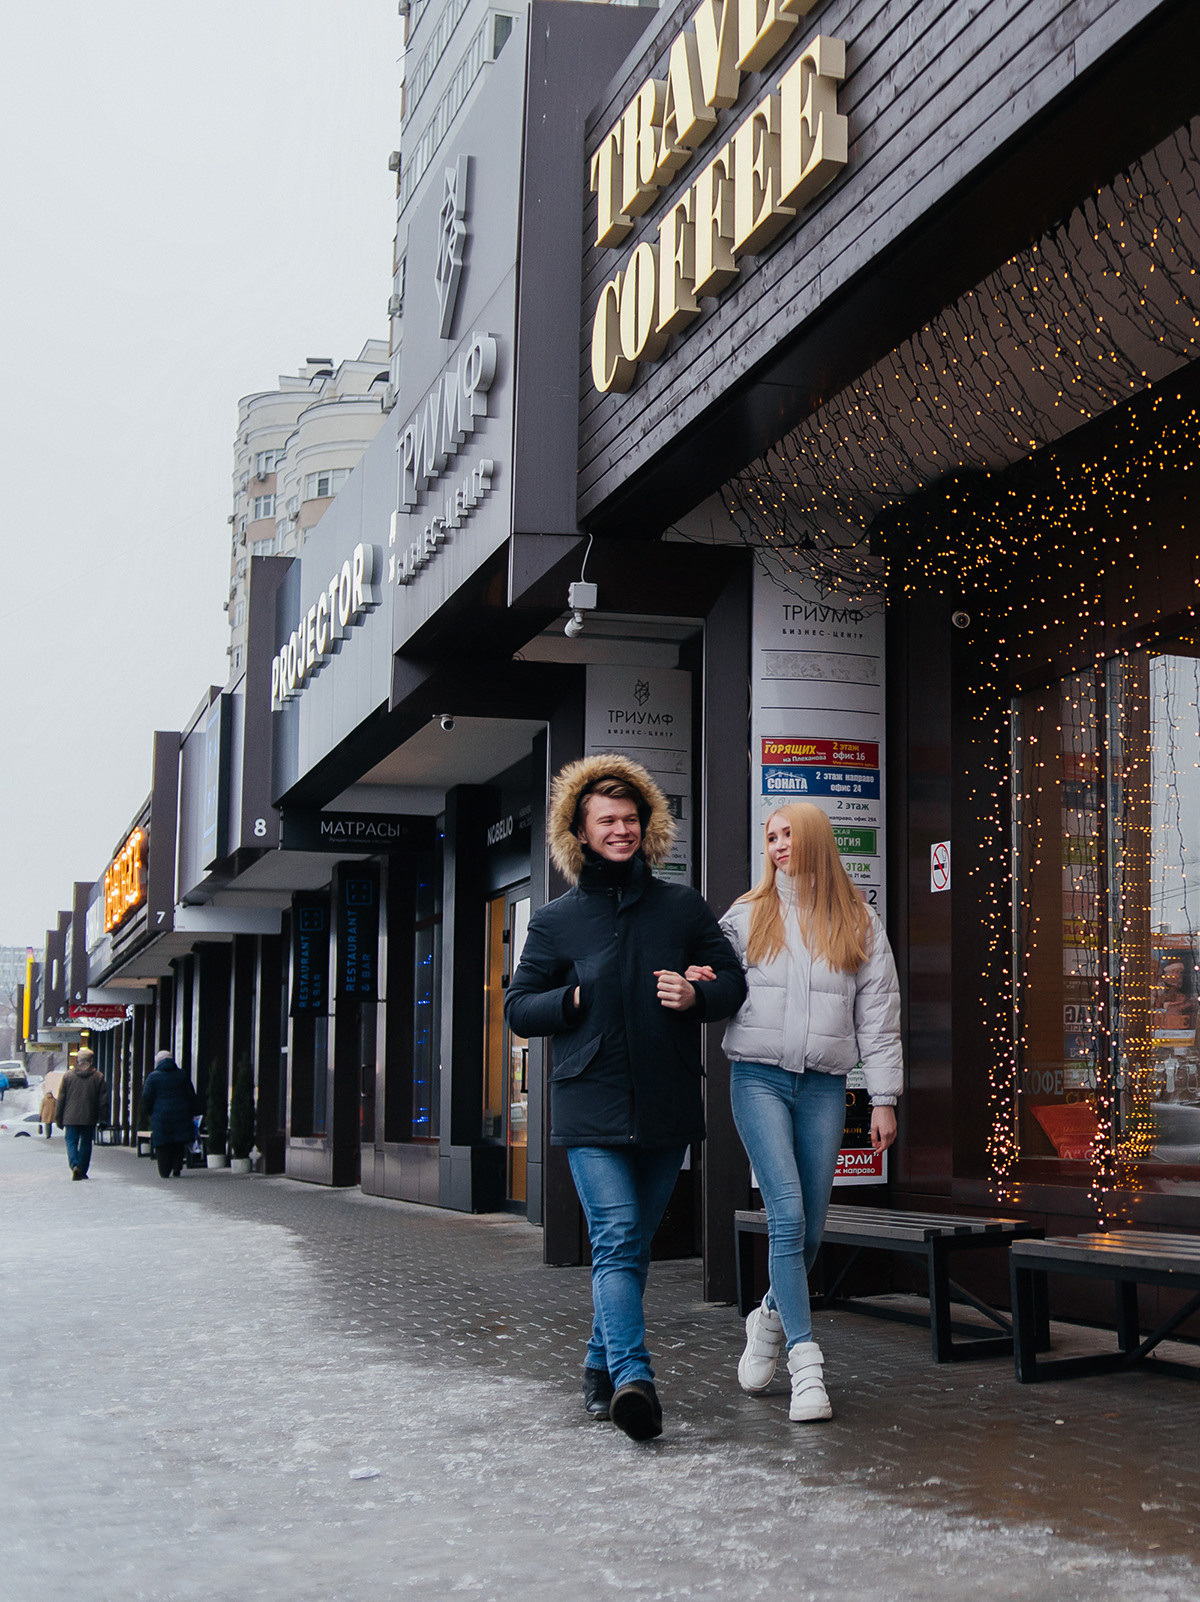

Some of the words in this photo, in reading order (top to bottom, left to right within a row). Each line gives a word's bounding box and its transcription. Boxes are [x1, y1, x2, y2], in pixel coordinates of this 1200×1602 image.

[590, 0, 815, 249] TRAVE
[591, 34, 848, 393] COFFEE
[396, 331, 497, 514] ТРИУМФ
[782, 604, 864, 625] ТРИУМФ
[271, 542, 373, 712] PROJECTOR
[782, 628, 863, 639] БИЗНЕС-ЦЕНТР
[608, 710, 674, 726] ТРИУМФ
[607, 729, 673, 737] БИЗНЕС-ЦЕНТР
[764, 744, 817, 755] ГОРЯЩИХ
[832, 742, 838, 750] 2
[839, 744, 860, 752] этаж
[832, 751, 854, 761] офис
[856, 752, 866, 761] 16
[767, 778, 808, 790] СОНАТА
[816, 771, 821, 779] 2
[823, 773, 843, 781] этаж
[845, 774, 874, 783] направо
[830, 784, 851, 793] офис
[853, 784, 862, 792] 24
[837, 800, 843, 809] 2
[845, 802, 869, 810] этаж
[253, 818, 267, 838] 8
[320, 820, 400, 837] МАТРАСЫ
[845, 862, 871, 872] этаж
[868, 889, 877, 905] 2
[156, 911, 165, 925] 7
[346, 910, 358, 992] RESTAURANT
[299, 935, 310, 1008] RESTAURANT
[361, 953, 371, 979] BAR
[312, 973, 322, 996] BAR
[75, 991, 82, 1000] 6
[59, 1006, 65, 1015] 5
[843, 1167, 875, 1175] направо
